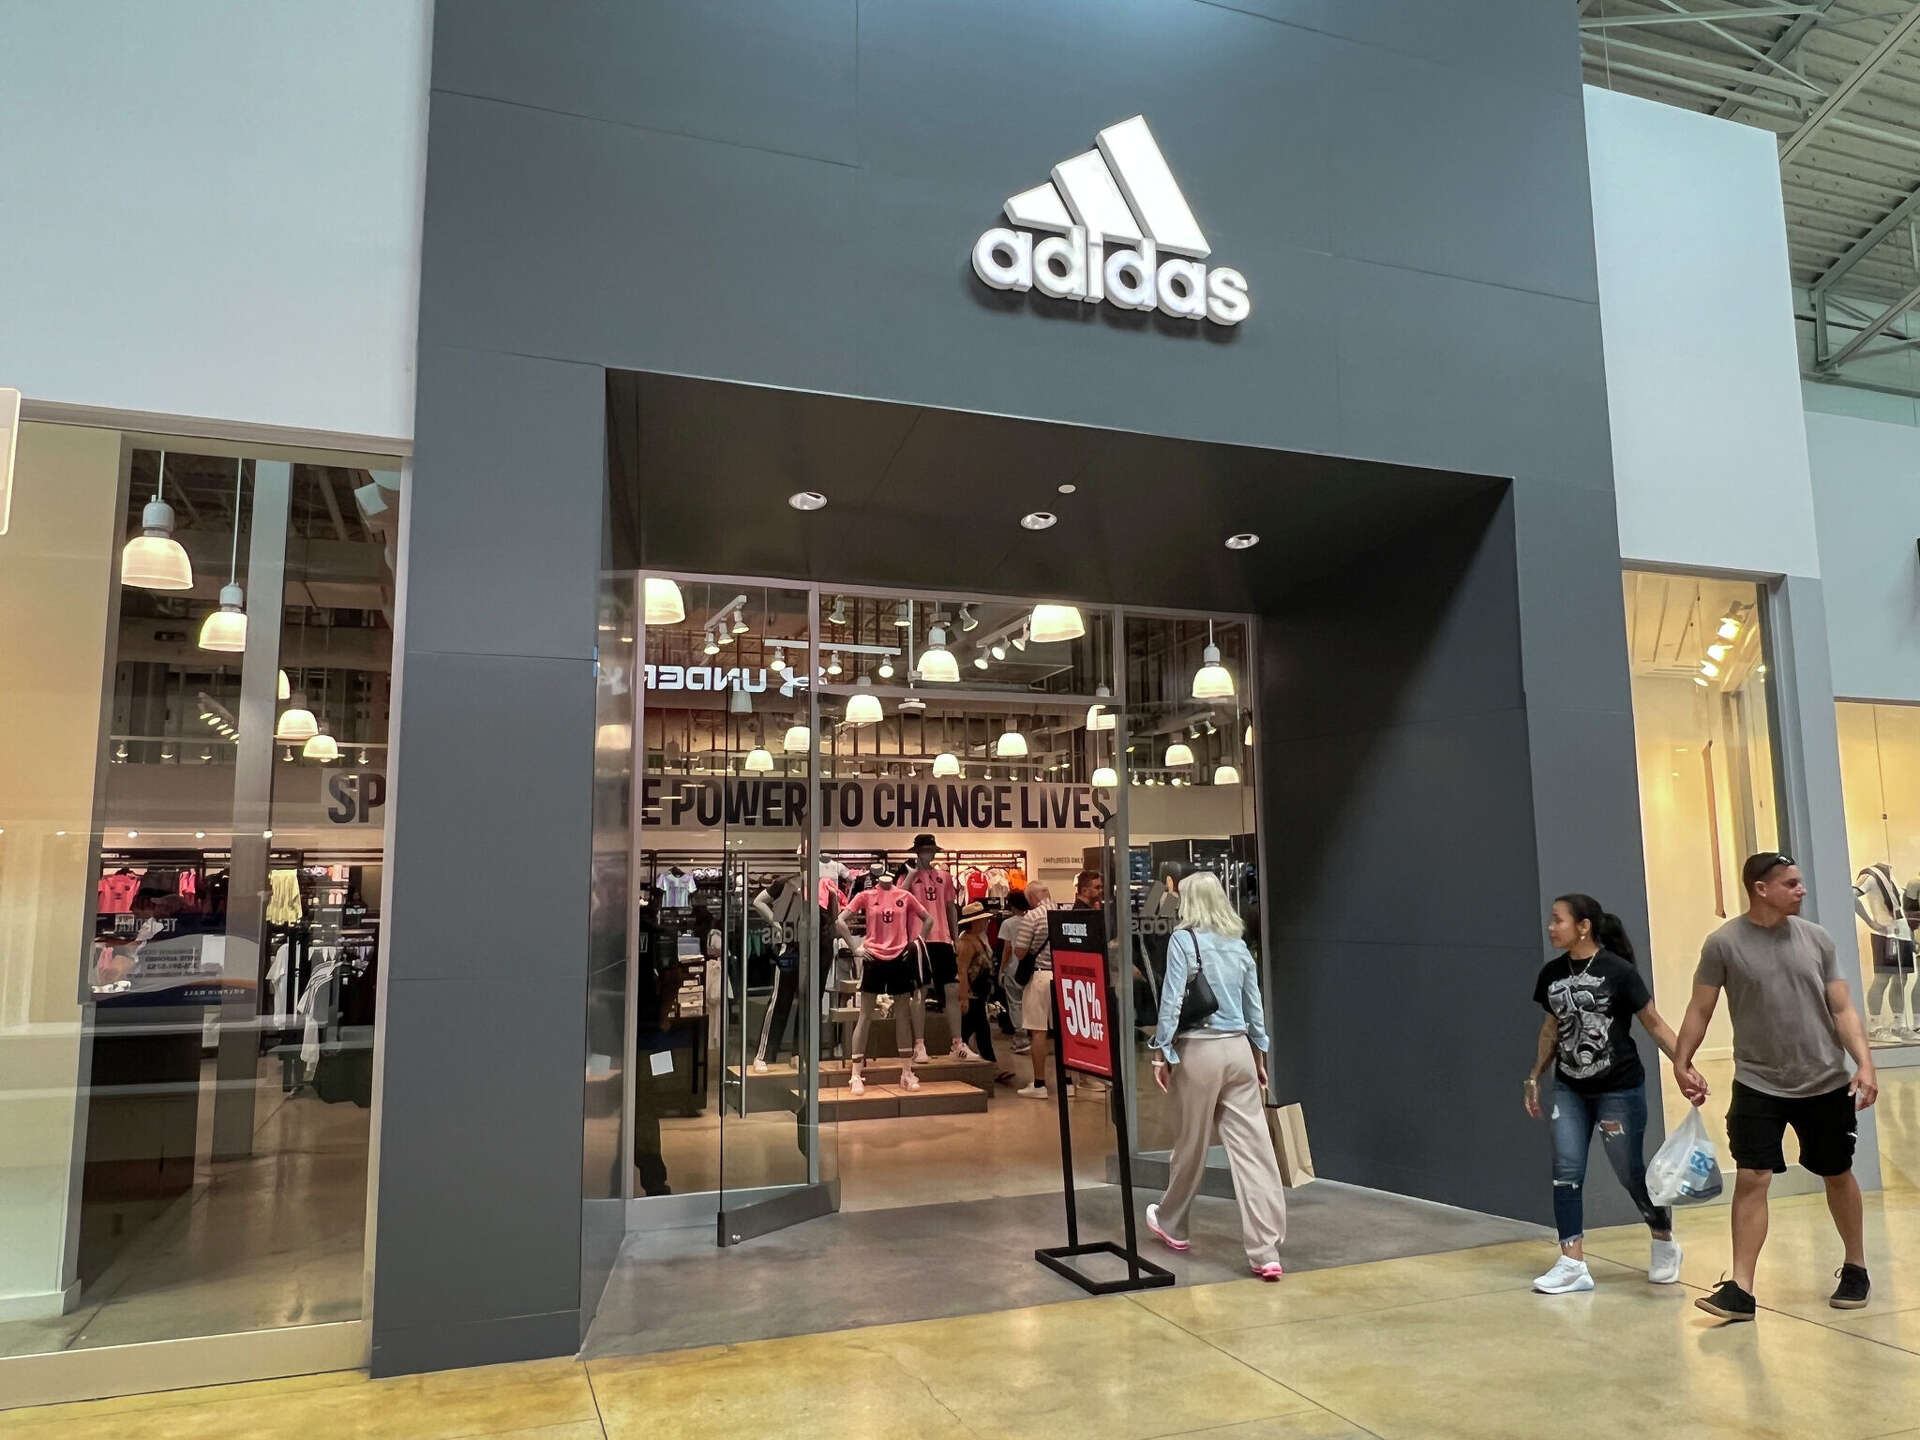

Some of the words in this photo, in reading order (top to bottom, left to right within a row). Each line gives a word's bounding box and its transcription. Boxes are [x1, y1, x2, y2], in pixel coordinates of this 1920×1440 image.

[972, 224, 1250, 326] adidas
[671, 780, 807, 826] POWER
[820, 781, 864, 827] TO
[873, 783, 1013, 829] CHANGE
[1021, 784, 1112, 829] LIVES
[1061, 978, 1102, 1039] 50%
[1090, 1021, 1104, 1041] OFF
